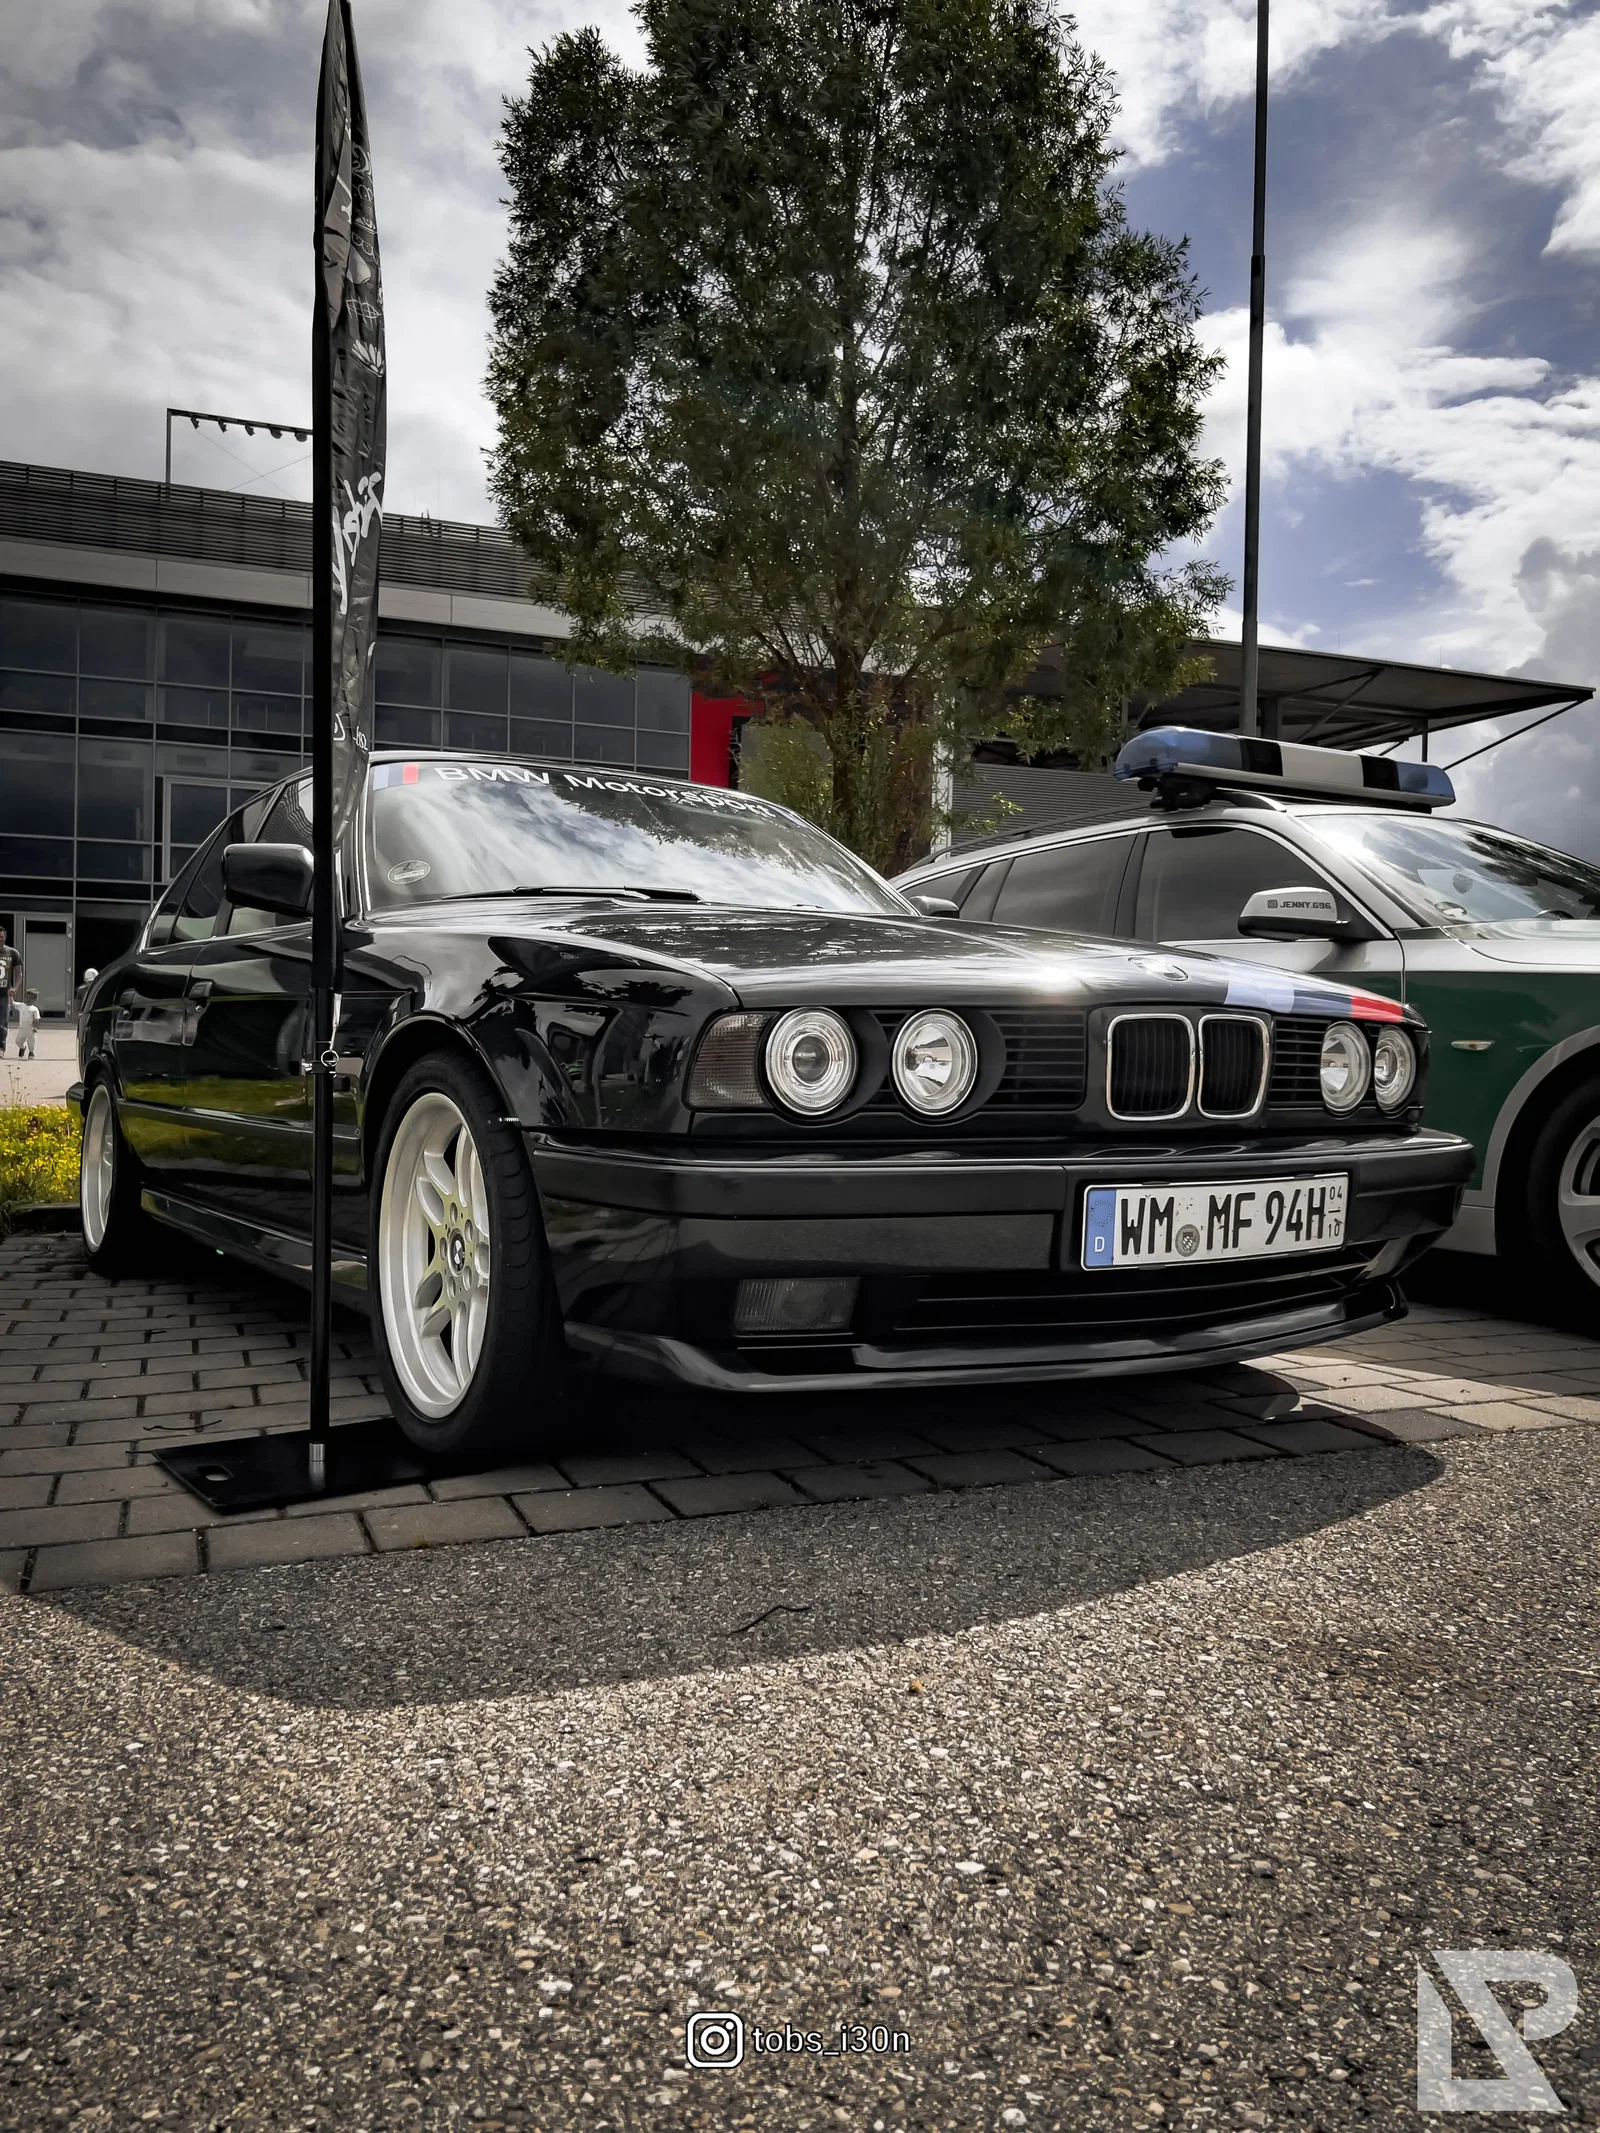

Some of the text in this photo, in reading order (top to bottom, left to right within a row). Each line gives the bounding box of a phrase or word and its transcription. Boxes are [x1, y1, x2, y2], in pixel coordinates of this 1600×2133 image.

[434, 767, 777, 818] BMW Motorsport
[1280, 901, 1332, 910] JENNY.G96
[1330, 1185, 1343, 1200] 04
[1094, 1186, 1326, 1256] D WM MF 94H
[1328, 1223, 1340, 1238] 10
